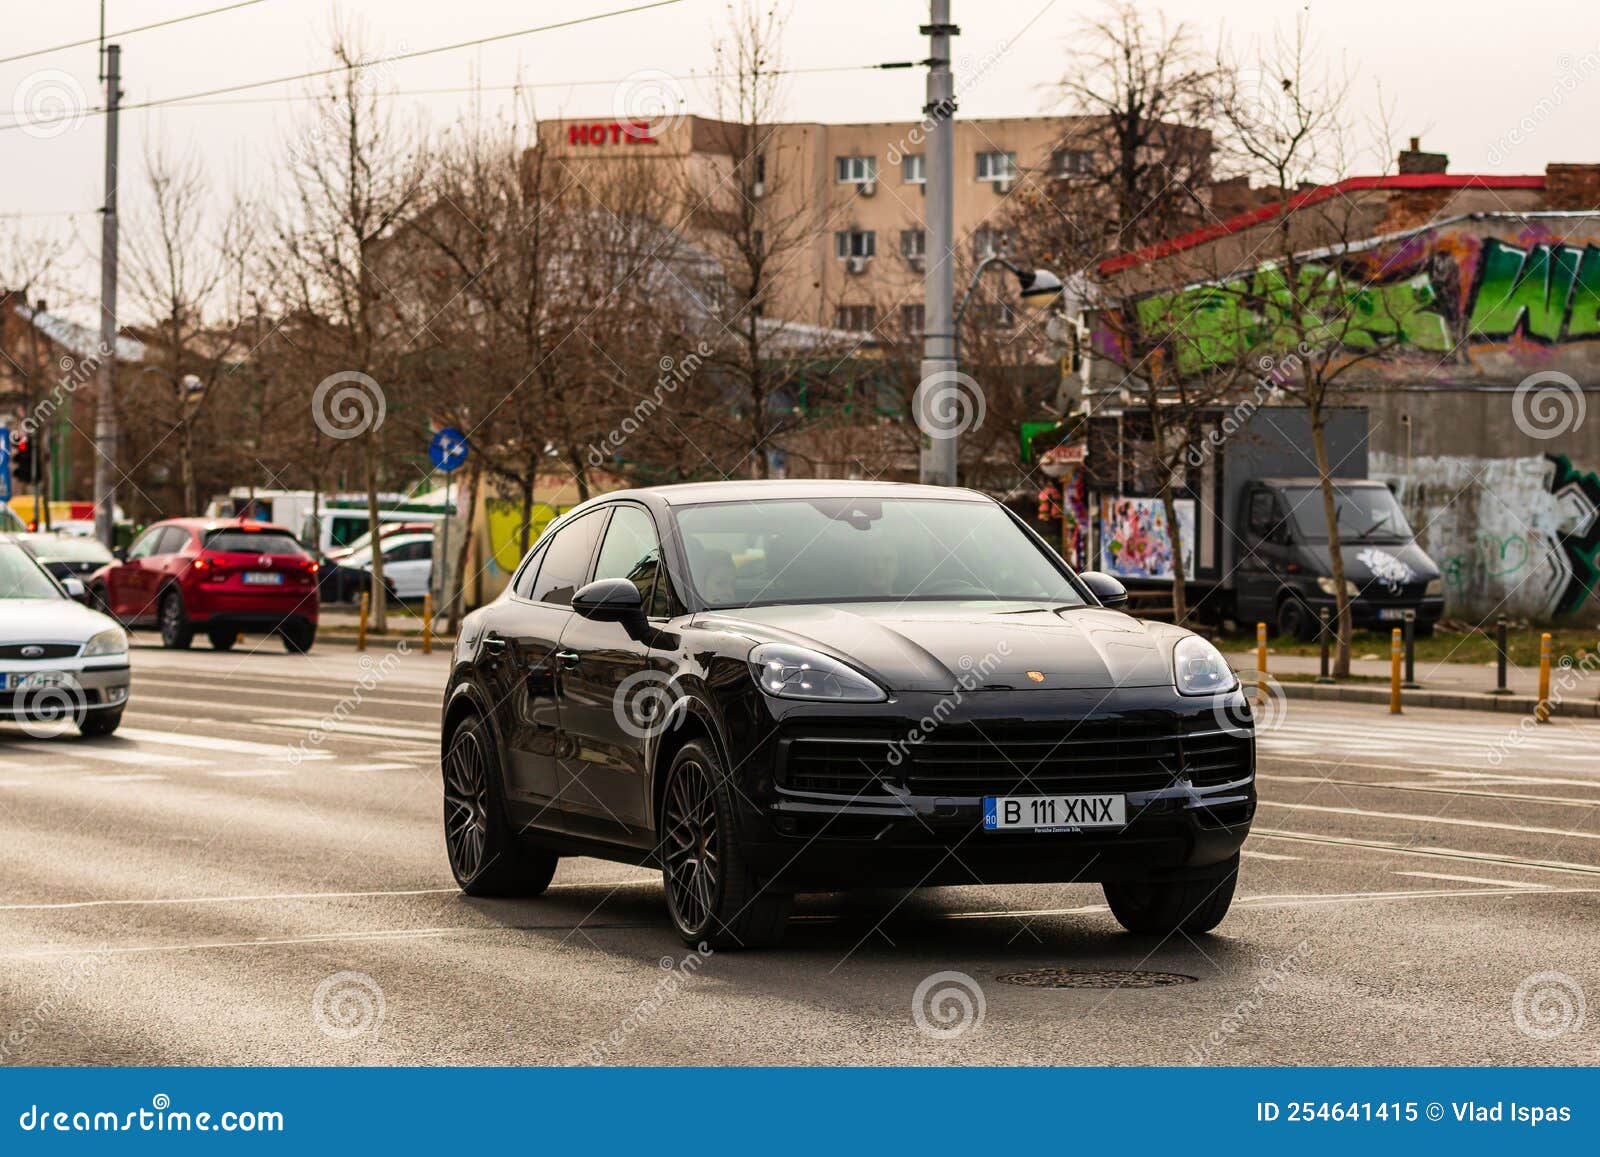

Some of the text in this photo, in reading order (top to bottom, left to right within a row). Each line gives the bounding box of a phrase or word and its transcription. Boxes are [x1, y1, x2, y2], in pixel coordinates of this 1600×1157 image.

[569, 122, 658, 145] HOTEL
[986, 815, 996, 825] RO
[1004, 798, 1113, 824] B 111 XNX
